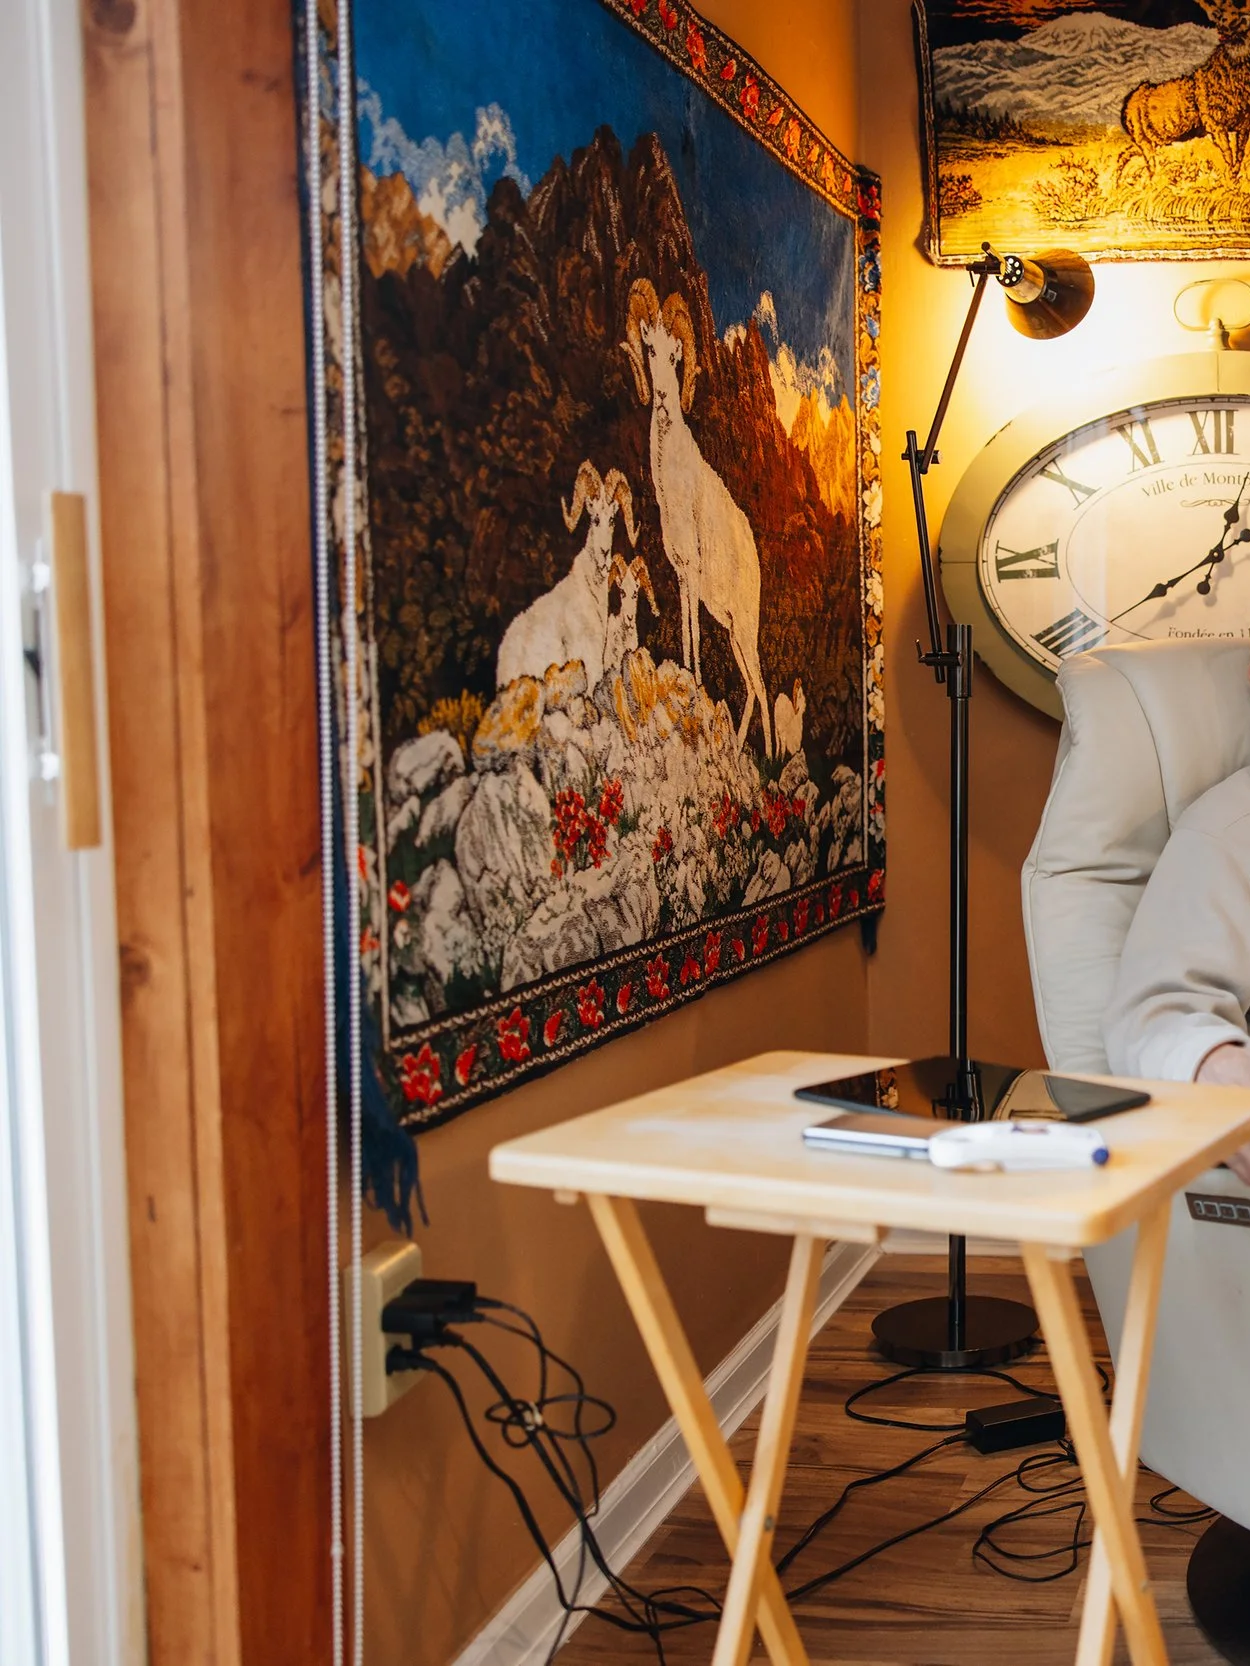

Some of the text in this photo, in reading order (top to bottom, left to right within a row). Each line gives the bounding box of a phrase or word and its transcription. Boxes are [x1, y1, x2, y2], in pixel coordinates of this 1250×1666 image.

[1110, 416, 1165, 475] XI
[1184, 409, 1240, 456] XII
[1031, 452, 1102, 510] X
[1141, 478, 1175, 497] Ville
[1179, 473, 1197, 488] de
[995, 538, 1060, 583] IX
[1219, 630, 1234, 639] en
